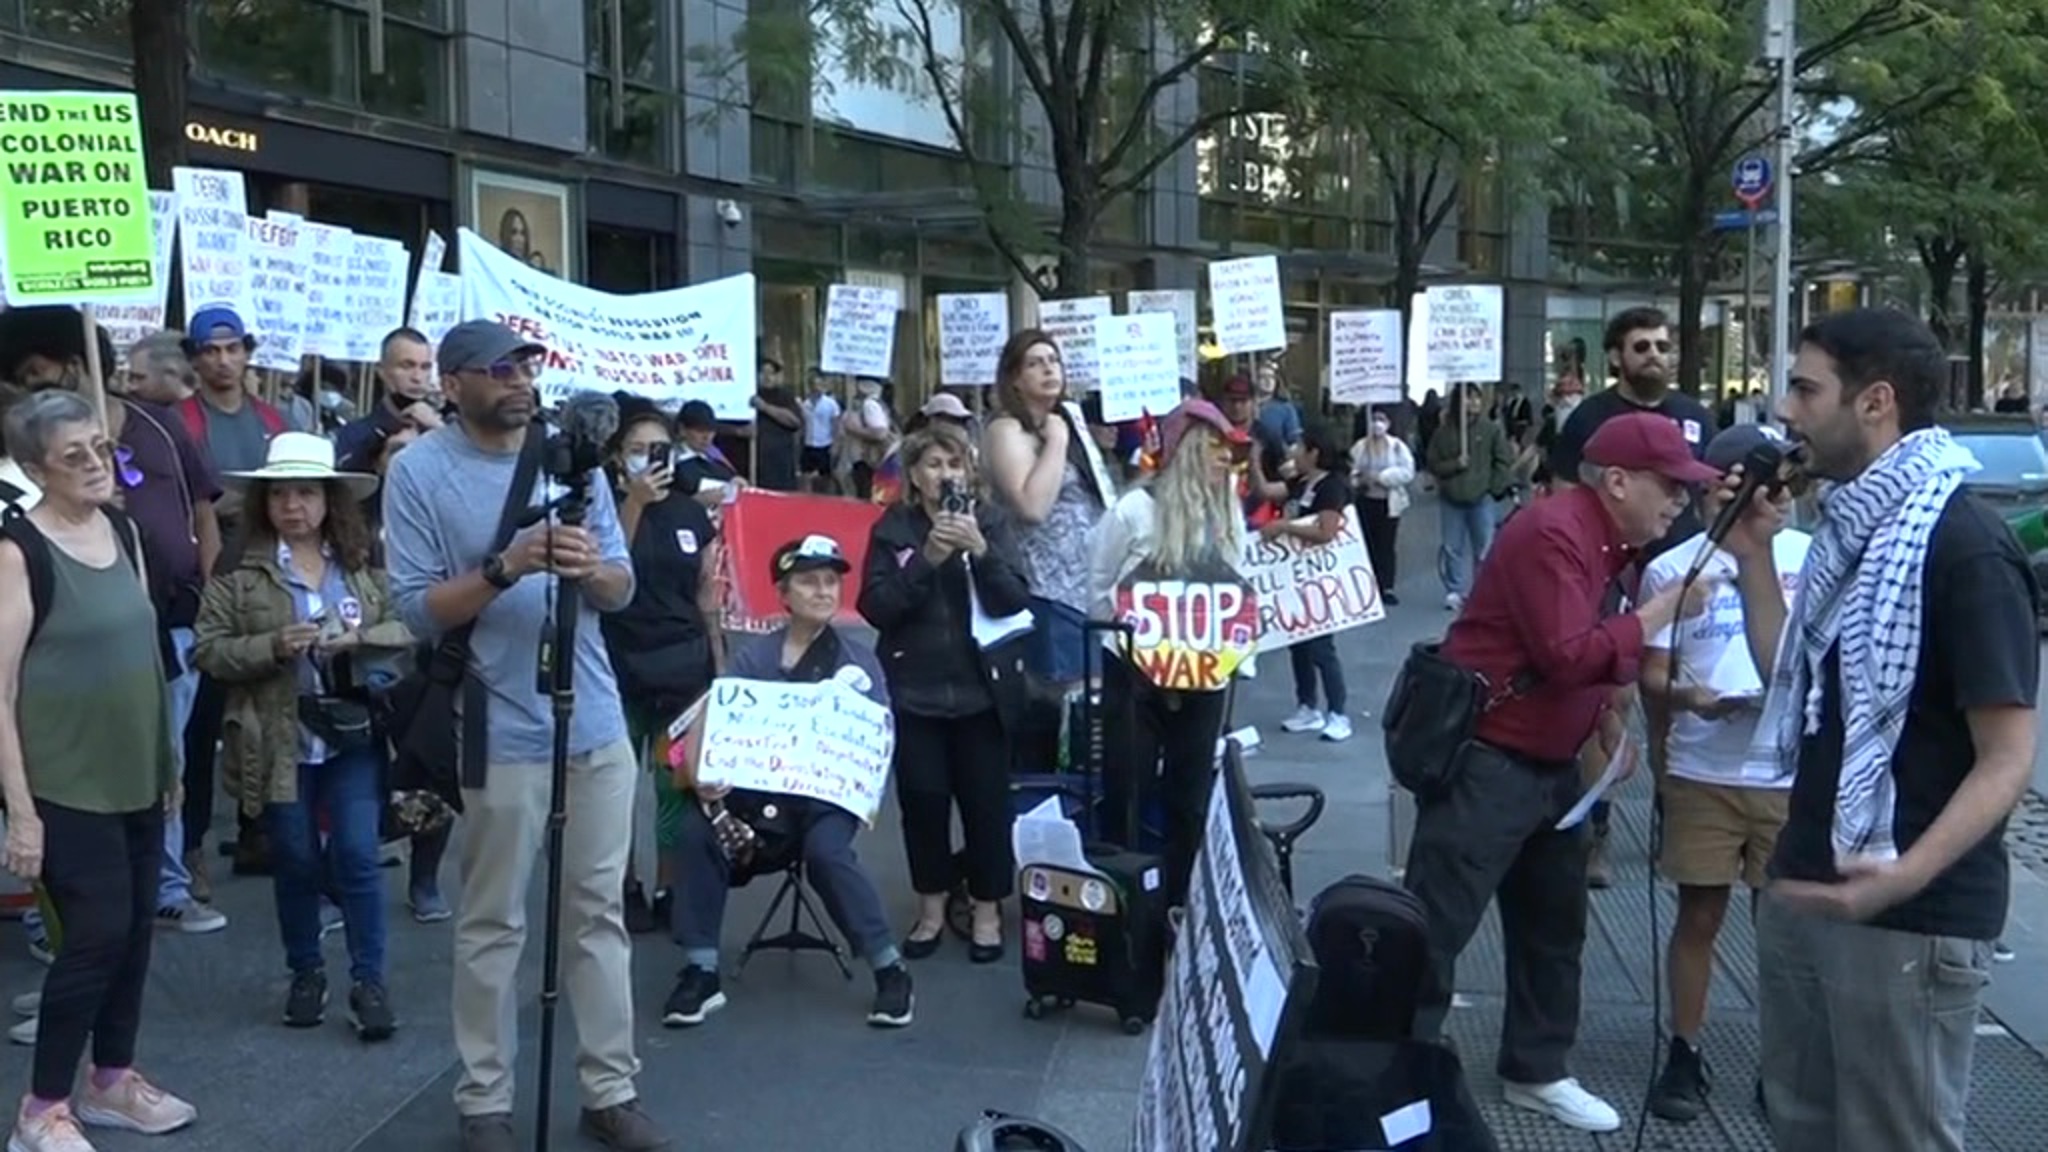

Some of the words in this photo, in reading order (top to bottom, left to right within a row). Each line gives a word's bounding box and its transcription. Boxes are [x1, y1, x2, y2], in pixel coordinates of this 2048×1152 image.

[56, 109, 88, 122] THE
[93, 104, 133, 123] US
[0, 134, 137, 153] COLONIAL
[7, 161, 87, 184] WAR
[93, 162, 131, 182] ON
[21, 198, 131, 219] PUERTO
[44, 228, 112, 249] RICO
[1291, 549, 1338, 583] END
[1273, 565, 1378, 633] WORLD
[1132, 579, 1243, 653] STOP
[1133, 649, 1223, 689] WAR
